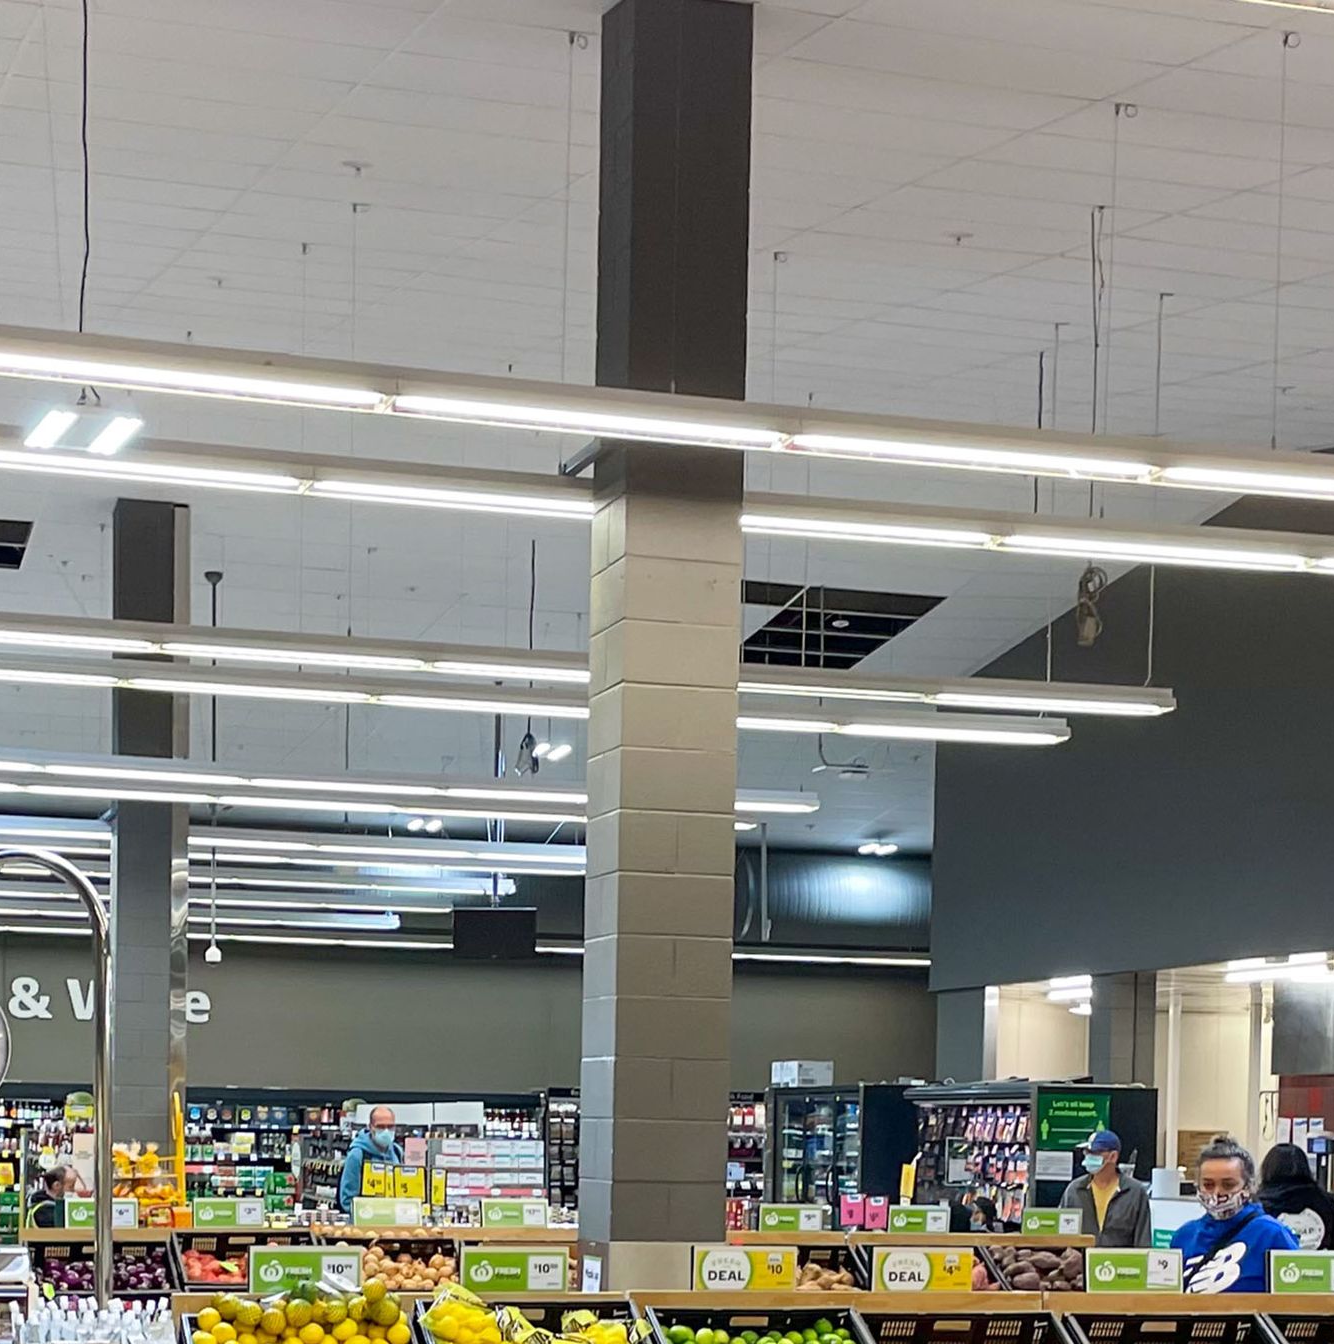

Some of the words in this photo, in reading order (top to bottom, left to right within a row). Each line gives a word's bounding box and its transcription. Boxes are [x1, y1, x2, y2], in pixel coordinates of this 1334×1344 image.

[8, 976, 53, 1020] &
[707, 1269, 746, 1283] DEAL
[888, 1270, 925, 1283] DEAL
